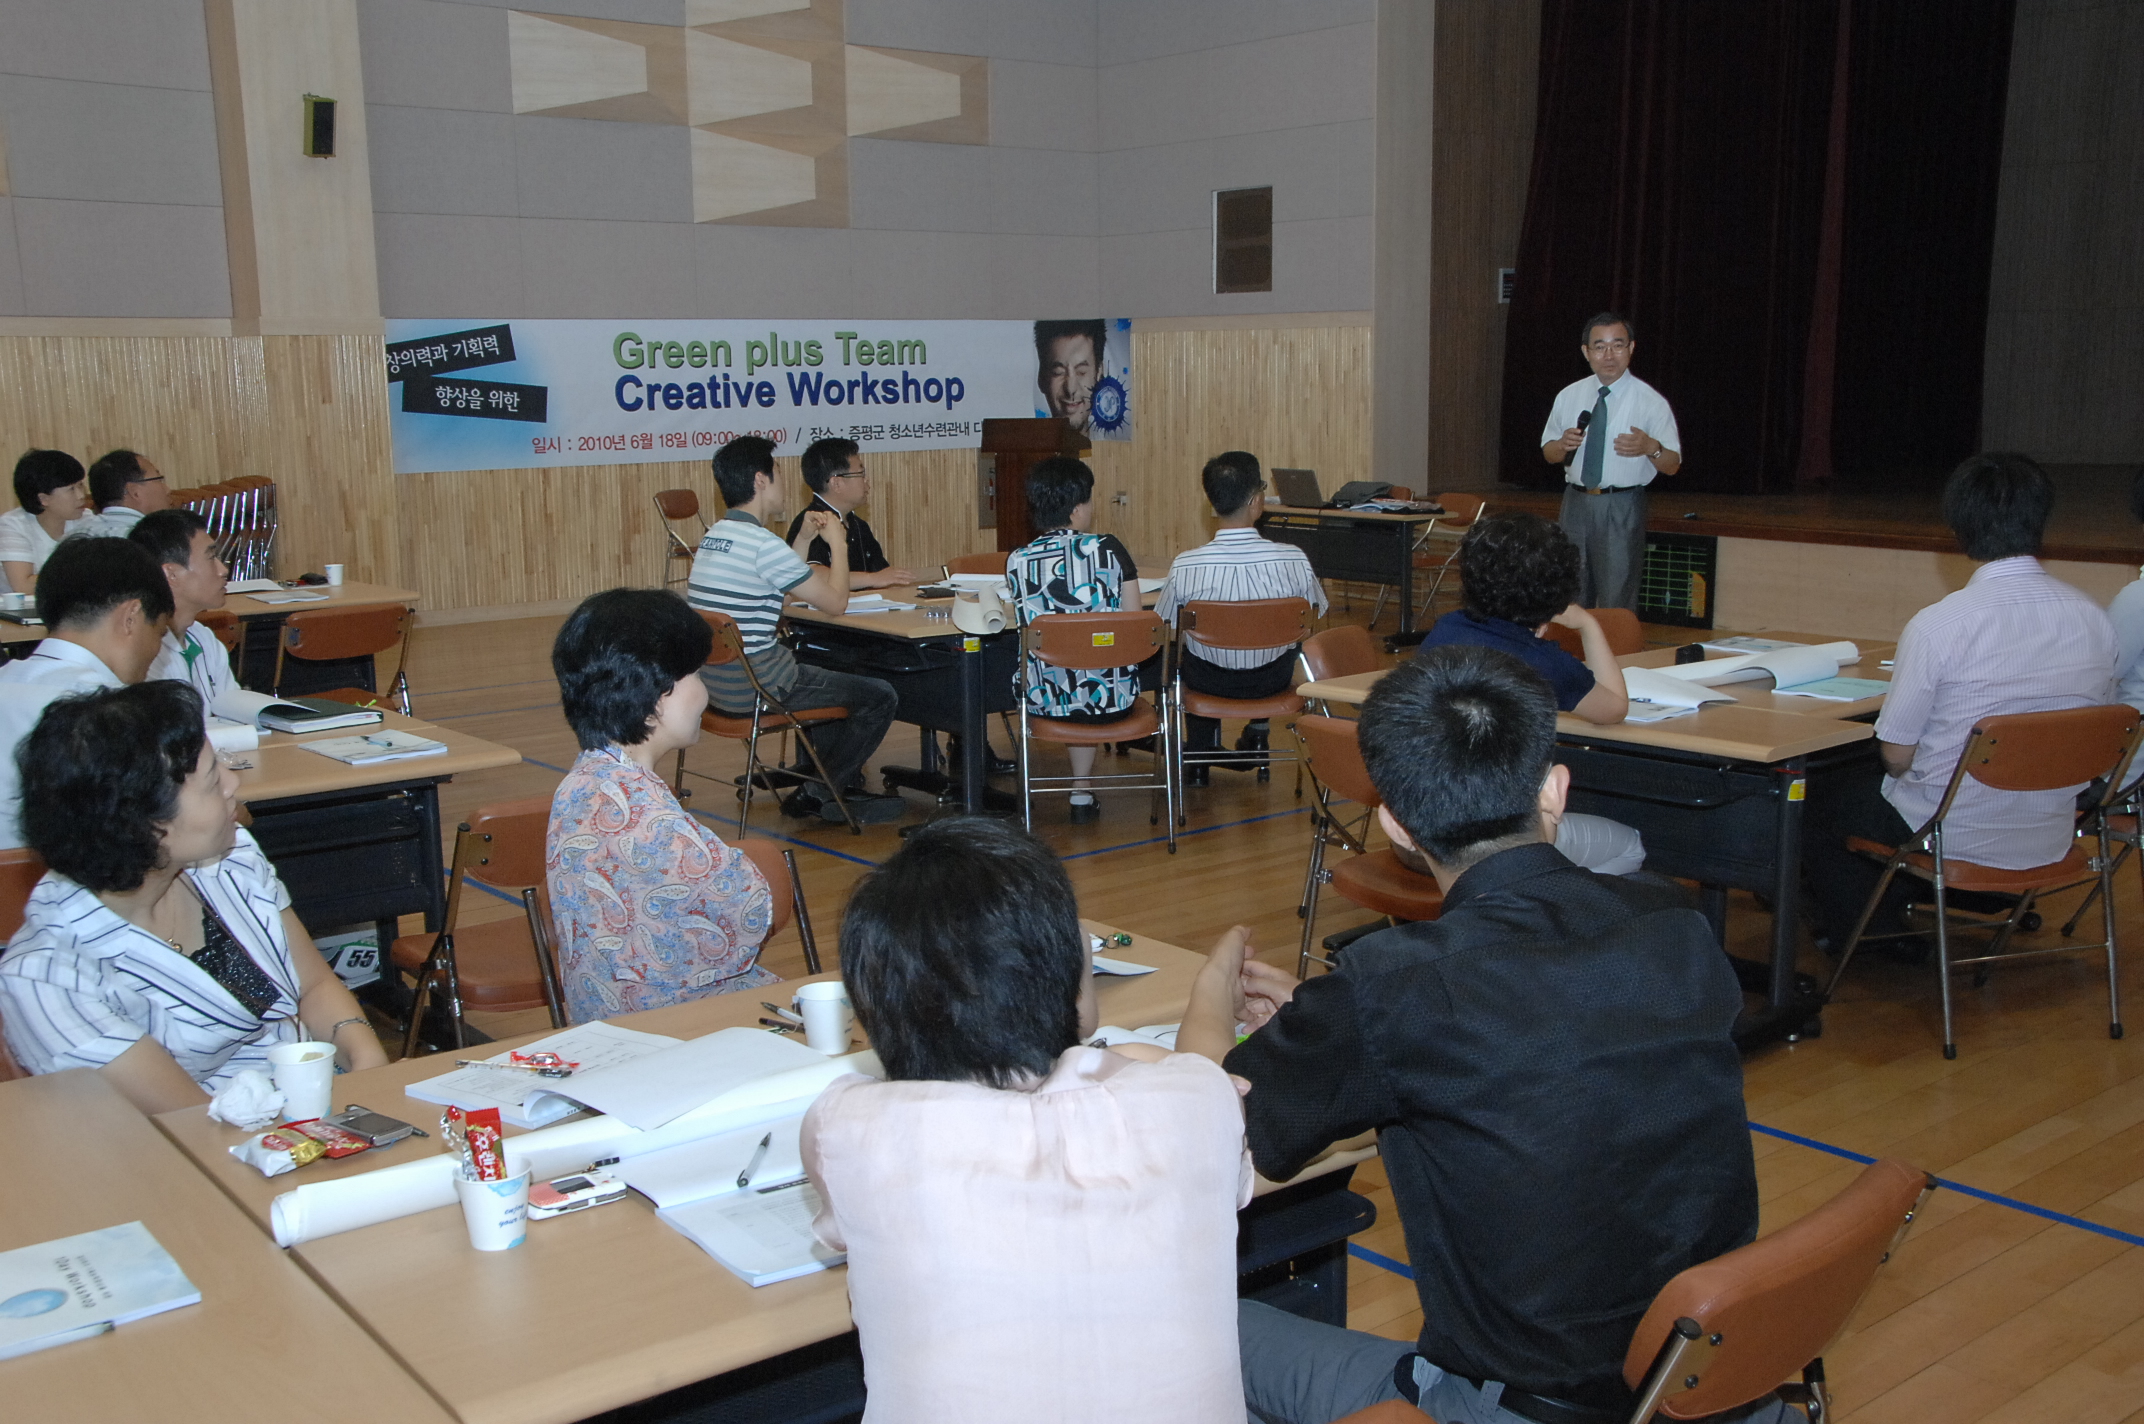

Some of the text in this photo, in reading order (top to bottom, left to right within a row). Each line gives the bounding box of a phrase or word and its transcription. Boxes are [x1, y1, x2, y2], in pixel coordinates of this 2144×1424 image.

[386, 334, 500, 374] 창의력과 기획력
[613, 331, 927, 376] Green plus Team
[435, 386, 521, 412] 향상을 위한
[614, 370, 965, 412] Creative Workshop
[531, 436, 562, 454] 일시
[578, 434, 626, 451] 2010년
[630, 432, 654, 450] 6월
[658, 431, 688, 448] 18일
[848, 424, 885, 441] 증평군
[888, 421, 970, 440] 청소년수련관내
[346, 949, 377, 968] 55
[504, 1203, 525, 1215] enjoy
